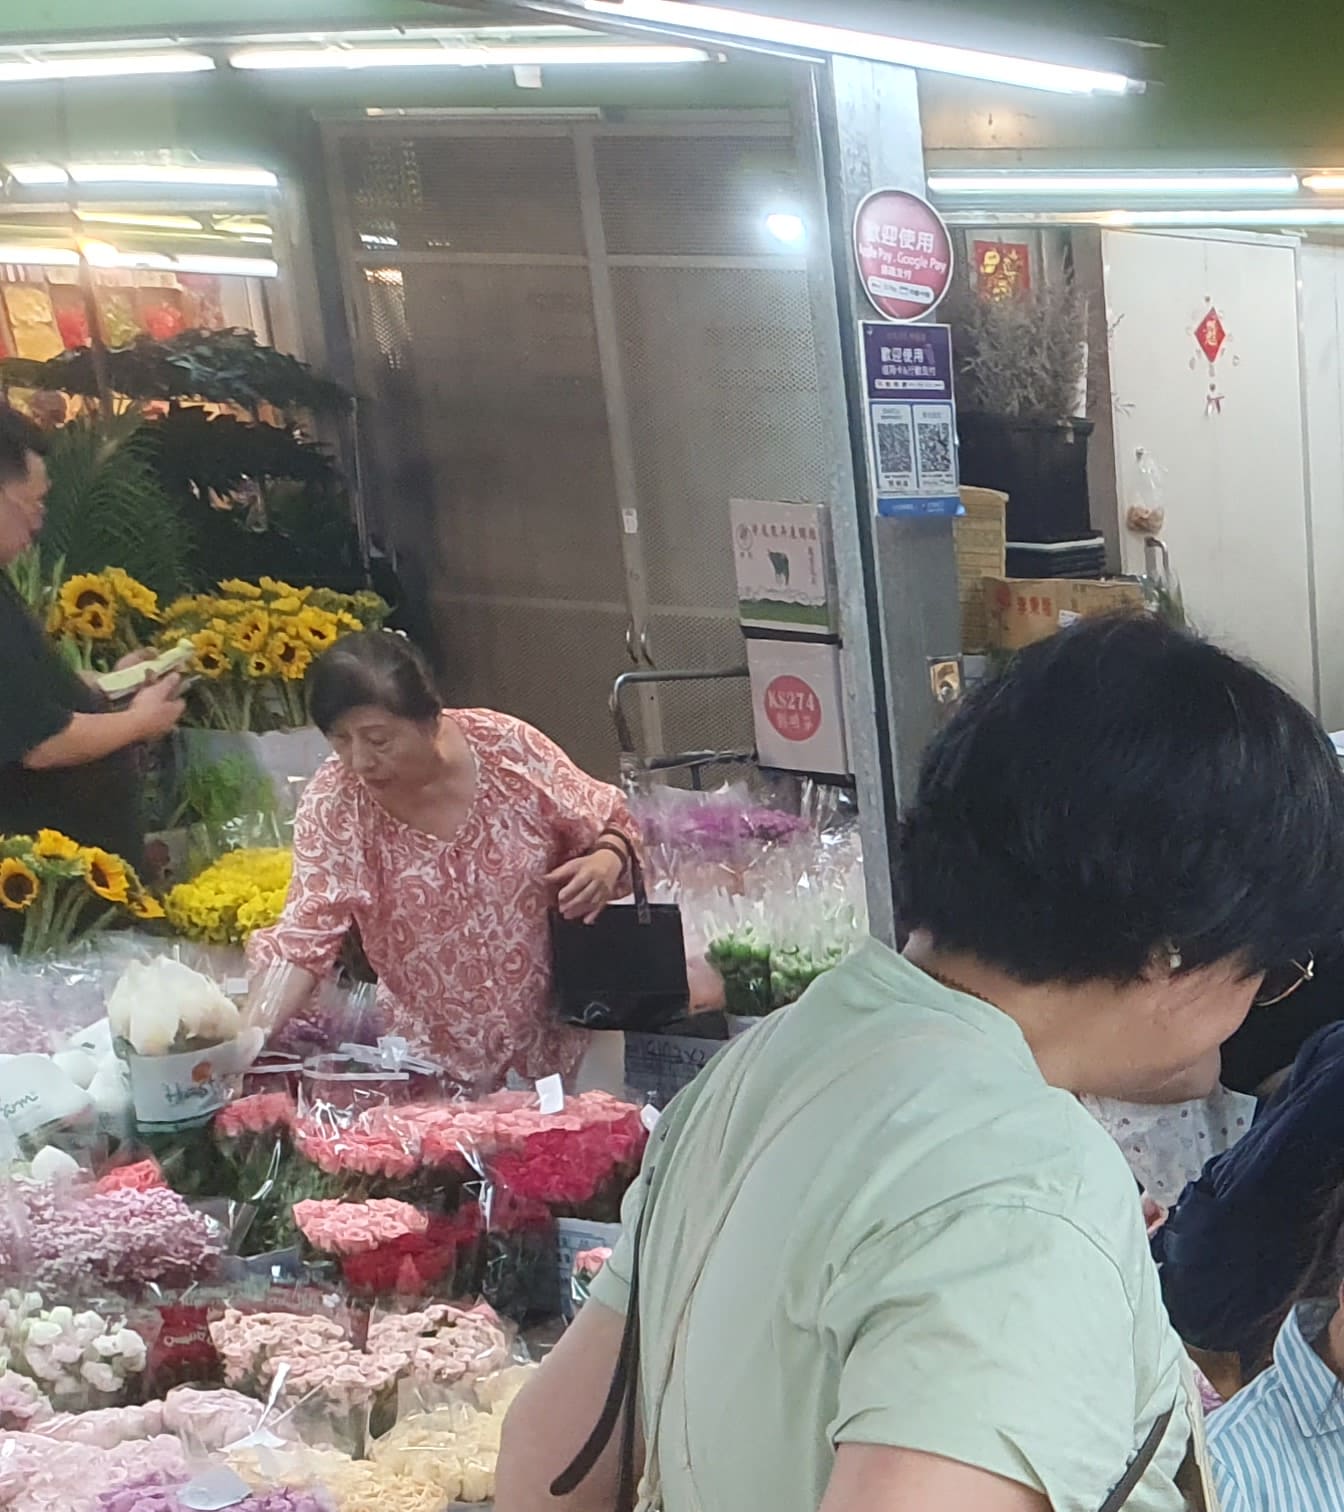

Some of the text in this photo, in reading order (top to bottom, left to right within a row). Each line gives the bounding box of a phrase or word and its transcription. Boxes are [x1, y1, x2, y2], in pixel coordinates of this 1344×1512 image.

[863, 221, 935, 254] 歡迎使用
[897, 251, 928, 270] Google
[929, 257, 947, 273] Pay
[881, 346, 924, 363] 歡迎使用
[767, 689, 815, 712] KS274
